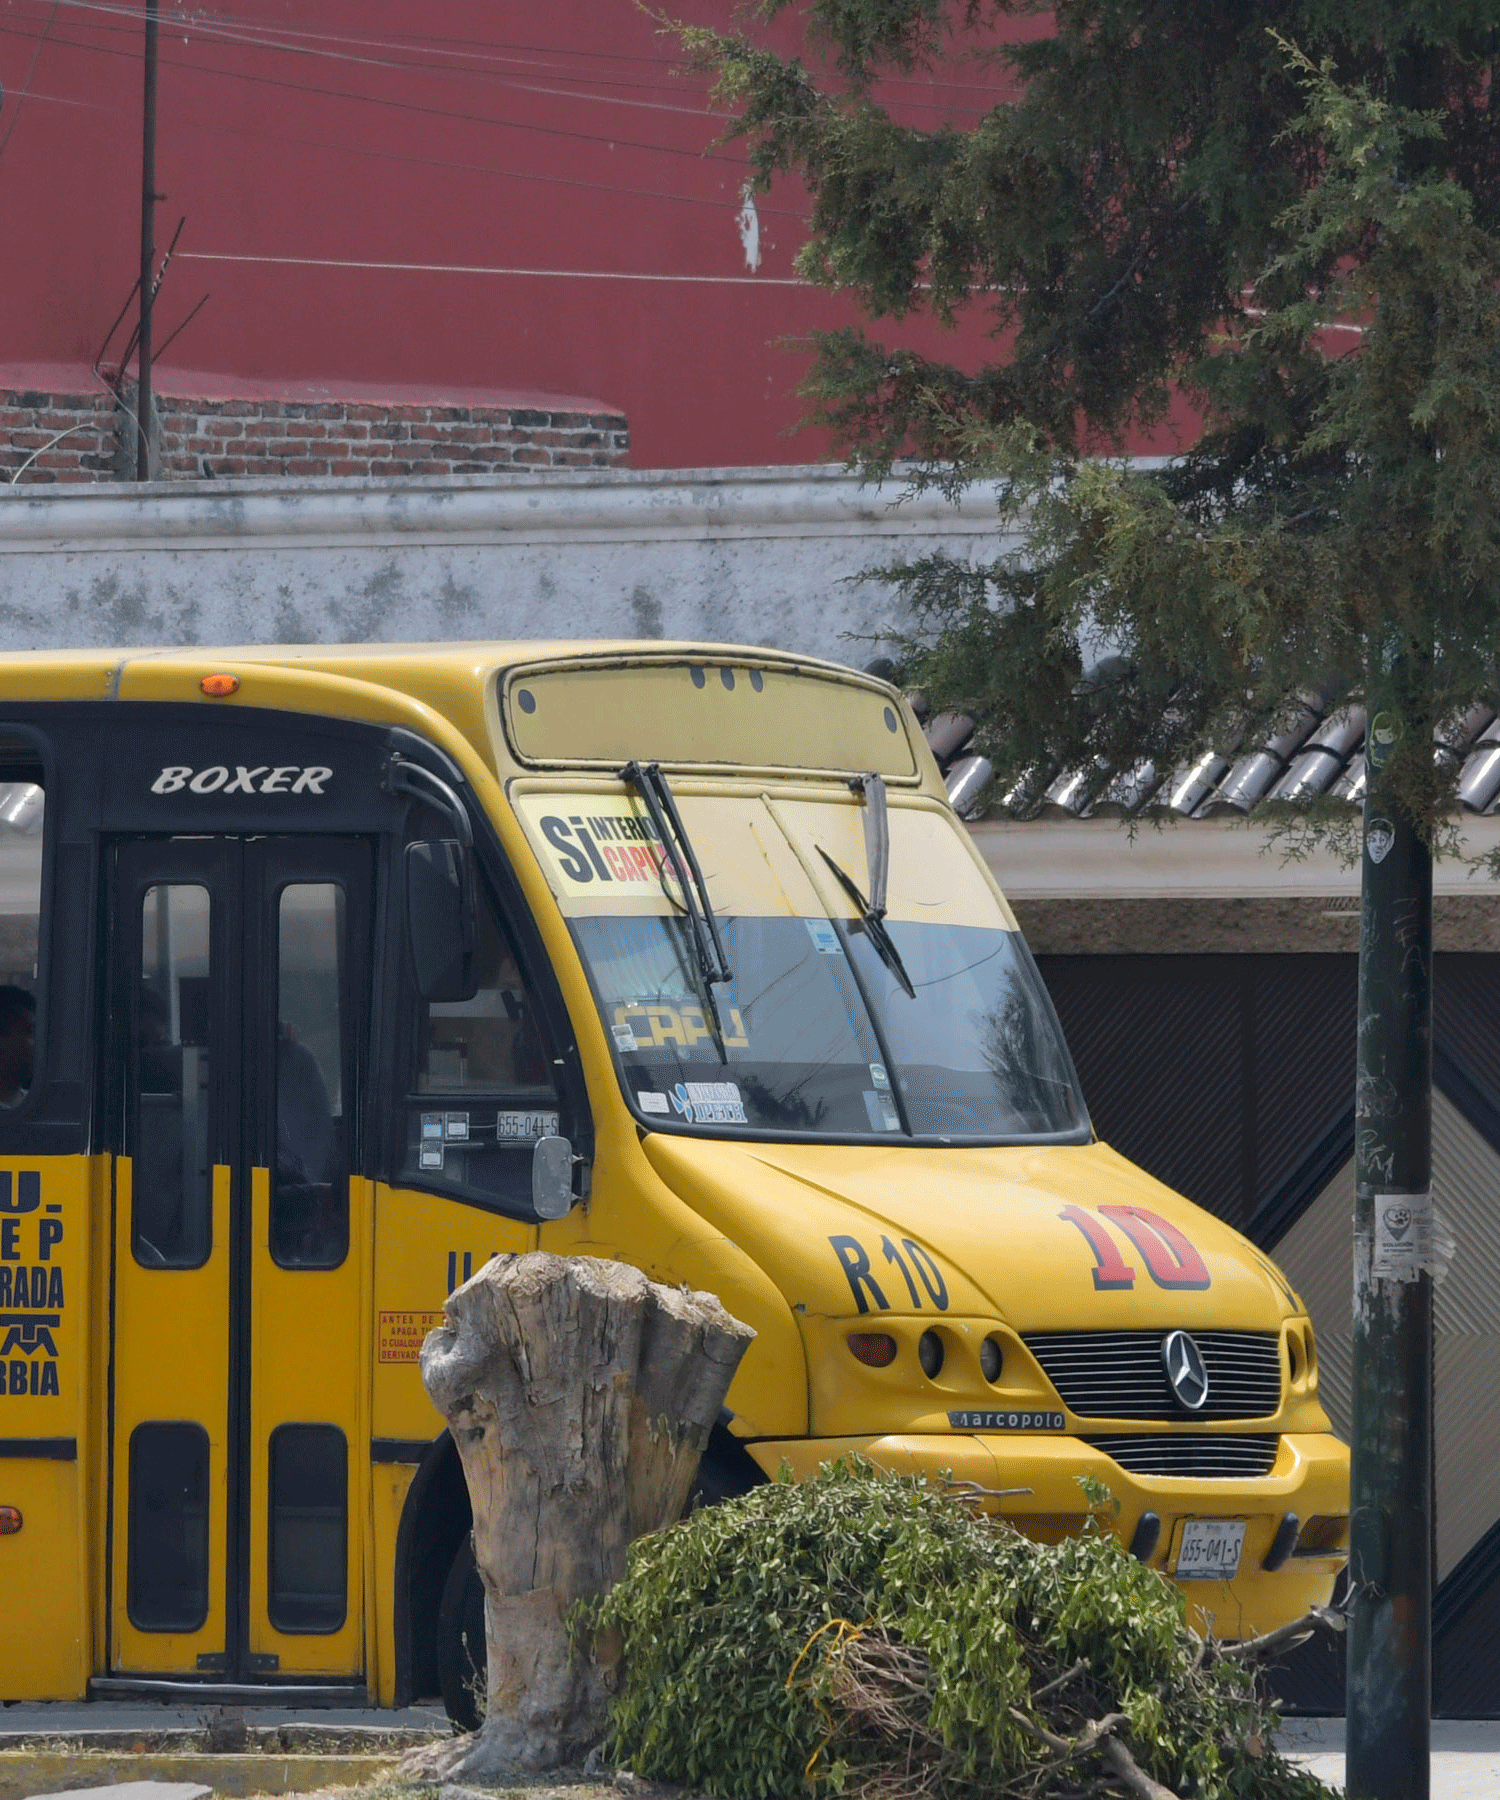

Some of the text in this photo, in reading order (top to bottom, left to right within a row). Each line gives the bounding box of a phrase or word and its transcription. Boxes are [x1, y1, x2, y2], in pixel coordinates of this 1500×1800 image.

[151, 766, 333, 795] BOXER
[539, 815, 662, 884] Si INTERIO
[603, 845, 662, 883] CAPU
[614, 1005, 750, 1047] CAPU
[499, 1116, 558, 1136] 655-041-S
[39, 1218, 64, 1261] P
[1058, 1204, 1211, 1291] 10
[828, 1234, 949, 1314] R 10
[382, 1315, 414, 1324] ANTES
[422, 1315, 435, 1324] DE
[391, 1327, 418, 1336] APAGA
[1182, 1538, 1242, 1562] 655-041-S
